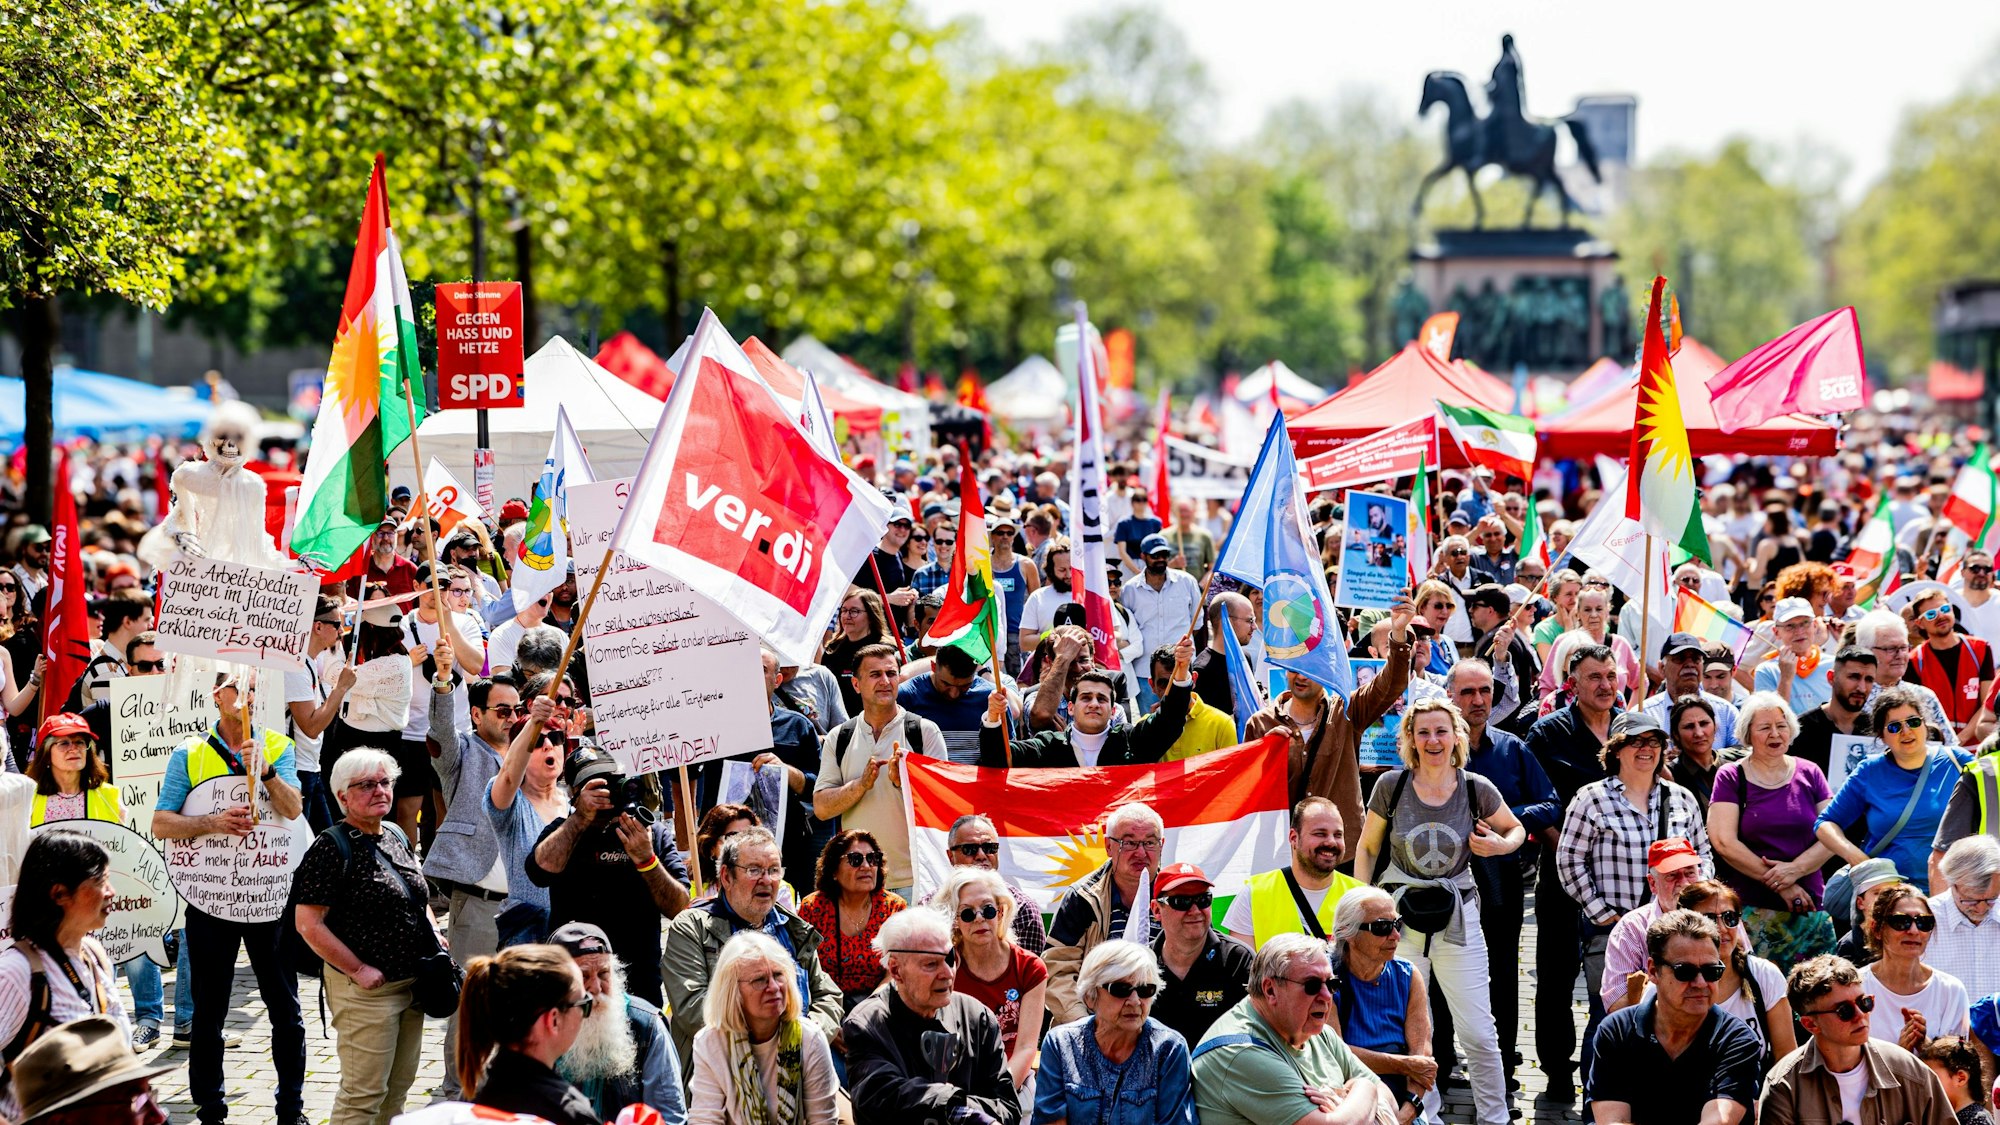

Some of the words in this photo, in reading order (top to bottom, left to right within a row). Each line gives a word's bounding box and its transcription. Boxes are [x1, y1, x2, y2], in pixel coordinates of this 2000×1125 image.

[453, 291, 473, 300] Deine
[474, 291, 502, 299] Stimme
[456, 312, 501, 326] GEGEN
[446, 328, 479, 340] HASS
[482, 327, 513, 340] UND
[458, 341, 500, 354] HETZE
[450, 373, 512, 401] SPD
[686, 472, 813, 583] ver.di
[169, 560, 197, 578] Die
[200, 564, 308, 597] Arbeitsbedin-
[164, 580, 221, 602] gungen
[223, 586, 242, 603] im
[242, 589, 304, 616] Handel
[161, 599, 205, 619] lassen
[207, 606, 240, 624] sich
[246, 611, 303, 635] rational
[158, 618, 228, 642] erklären:
[226, 627, 251, 647] Es
[169, 716, 209, 736] Handel
[598, 730, 627, 752] Fair
[121, 749, 137, 762] so
[630, 734, 721, 773] VERHANDELN
[121, 784, 147, 807] Wir
[169, 852, 201, 868] 250€
[205, 854, 231, 867] mehr
[232, 851, 250, 875] für
[252, 851, 289, 868] Azubis
[175, 871, 228, 889] gemeinsame
[230, 871, 288, 890] Beantragung
[207, 902, 225, 916] der
